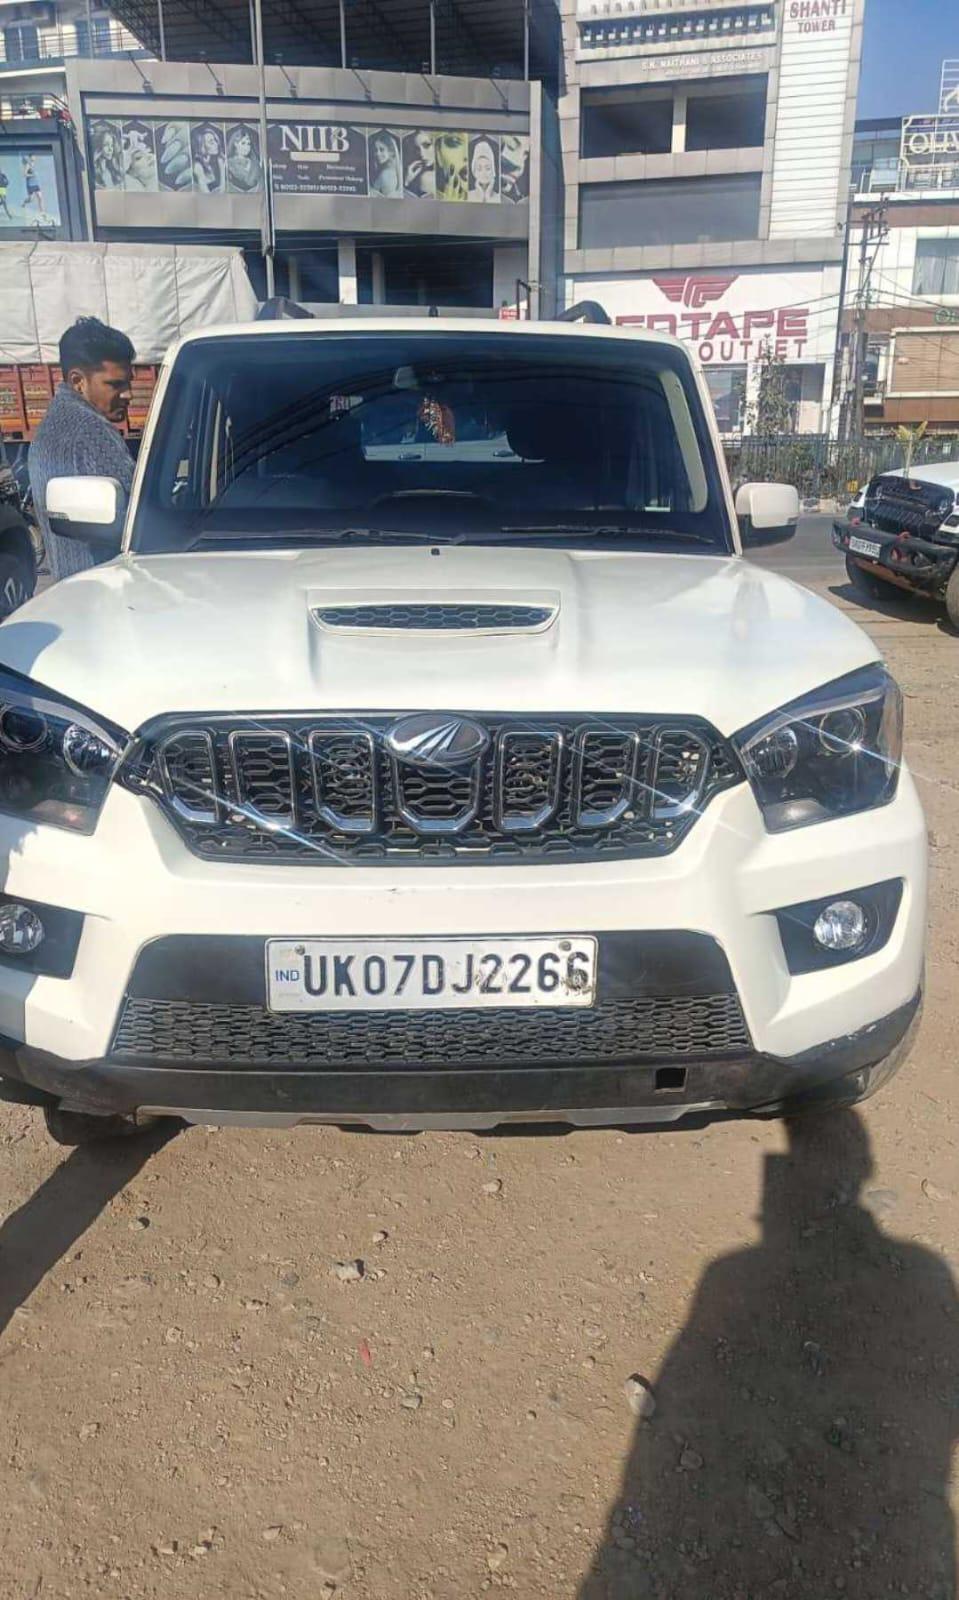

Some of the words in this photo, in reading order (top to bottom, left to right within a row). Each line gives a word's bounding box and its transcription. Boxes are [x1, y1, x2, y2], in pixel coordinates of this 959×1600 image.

[789, 0, 847, 18] SHANTI
[798, 19, 836, 33] TOWER
[699, 339, 807, 362] OUTLET
[275, 969, 300, 982] IND
[303, 951, 589, 996] UK07DJ2266
